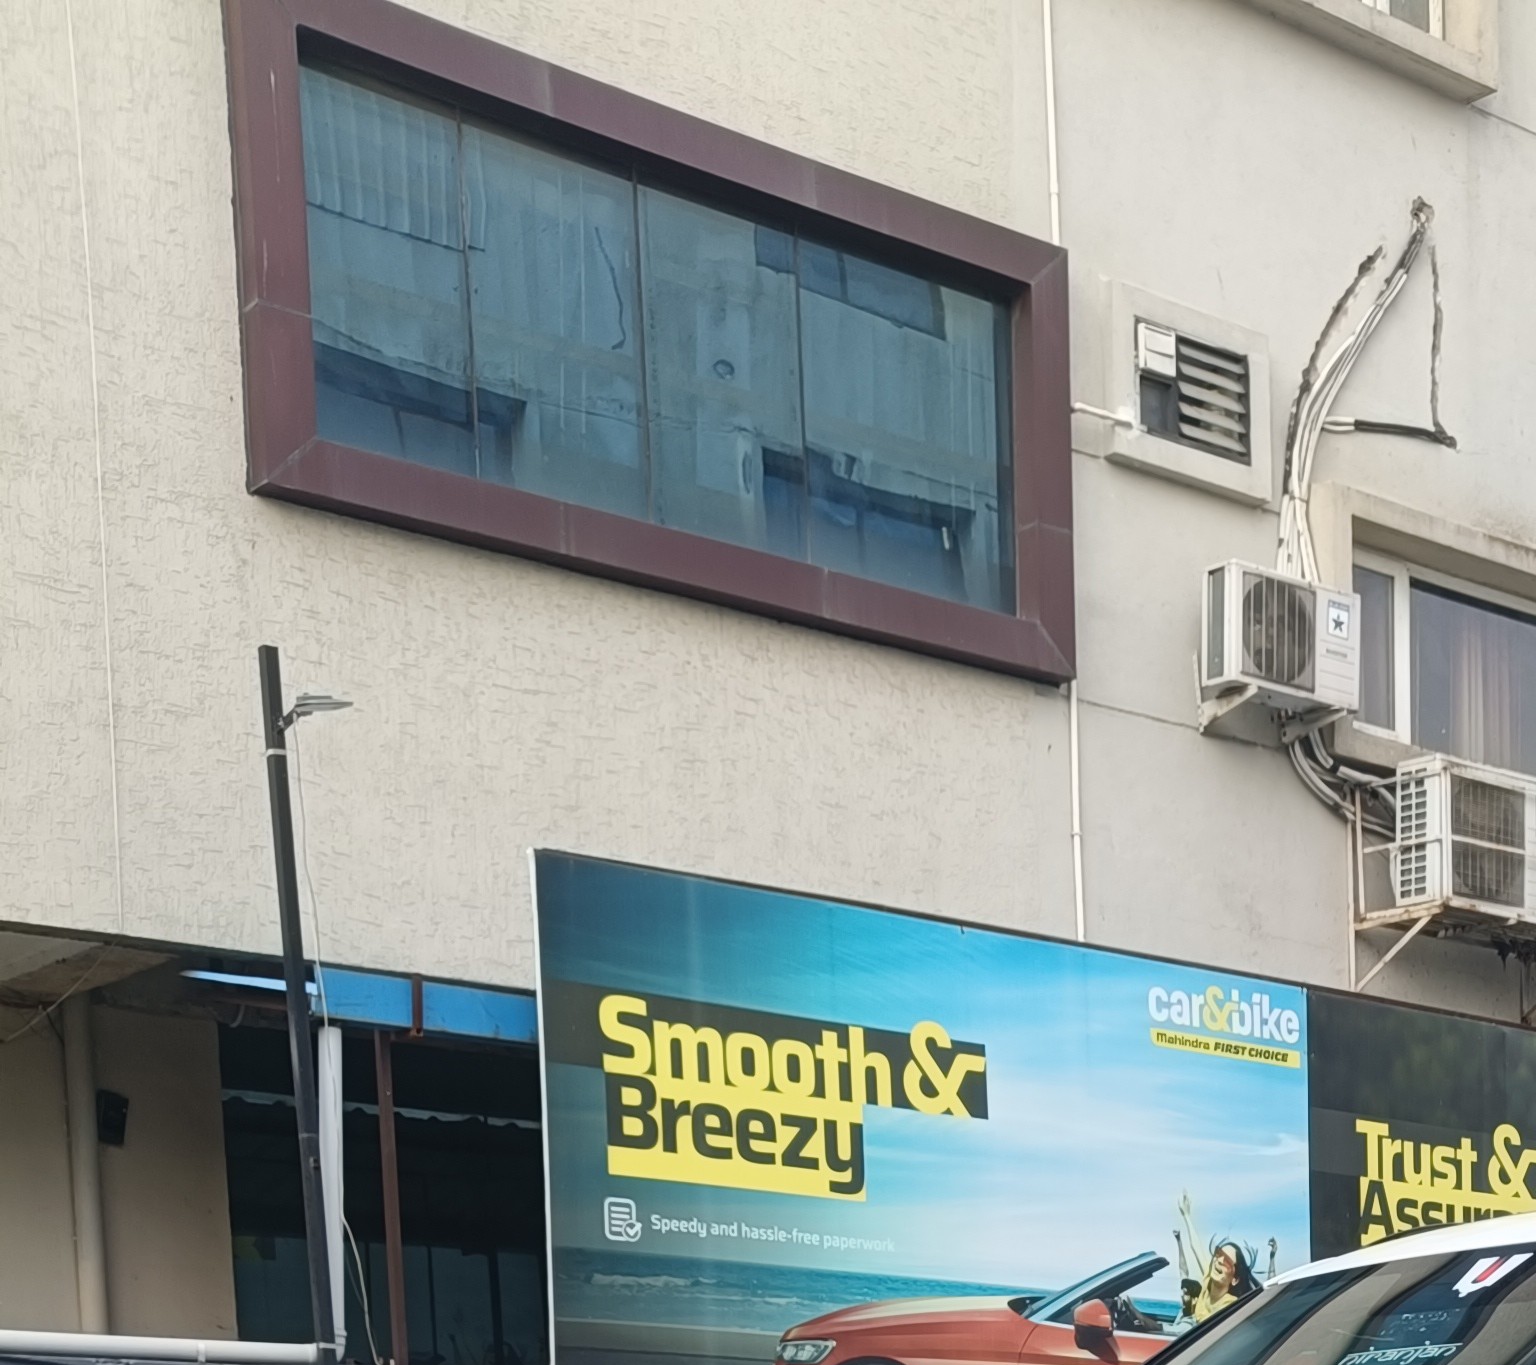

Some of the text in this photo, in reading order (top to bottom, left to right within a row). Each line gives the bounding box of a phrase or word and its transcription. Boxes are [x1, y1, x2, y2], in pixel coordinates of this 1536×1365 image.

[1149, 985, 1300, 1043] car&bike
[599, 995, 986, 1118] Smooth &
[1156, 1032, 1288, 1062] Mahindra FIRST CHOICE
[606, 1073, 864, 1194] Breezy
[1356, 1119, 1477, 1193] Trust
[650, 1213, 896, 1252] Speedy and hassle-free paperwork
[1338, 1340, 1463, 1365] niranjan
